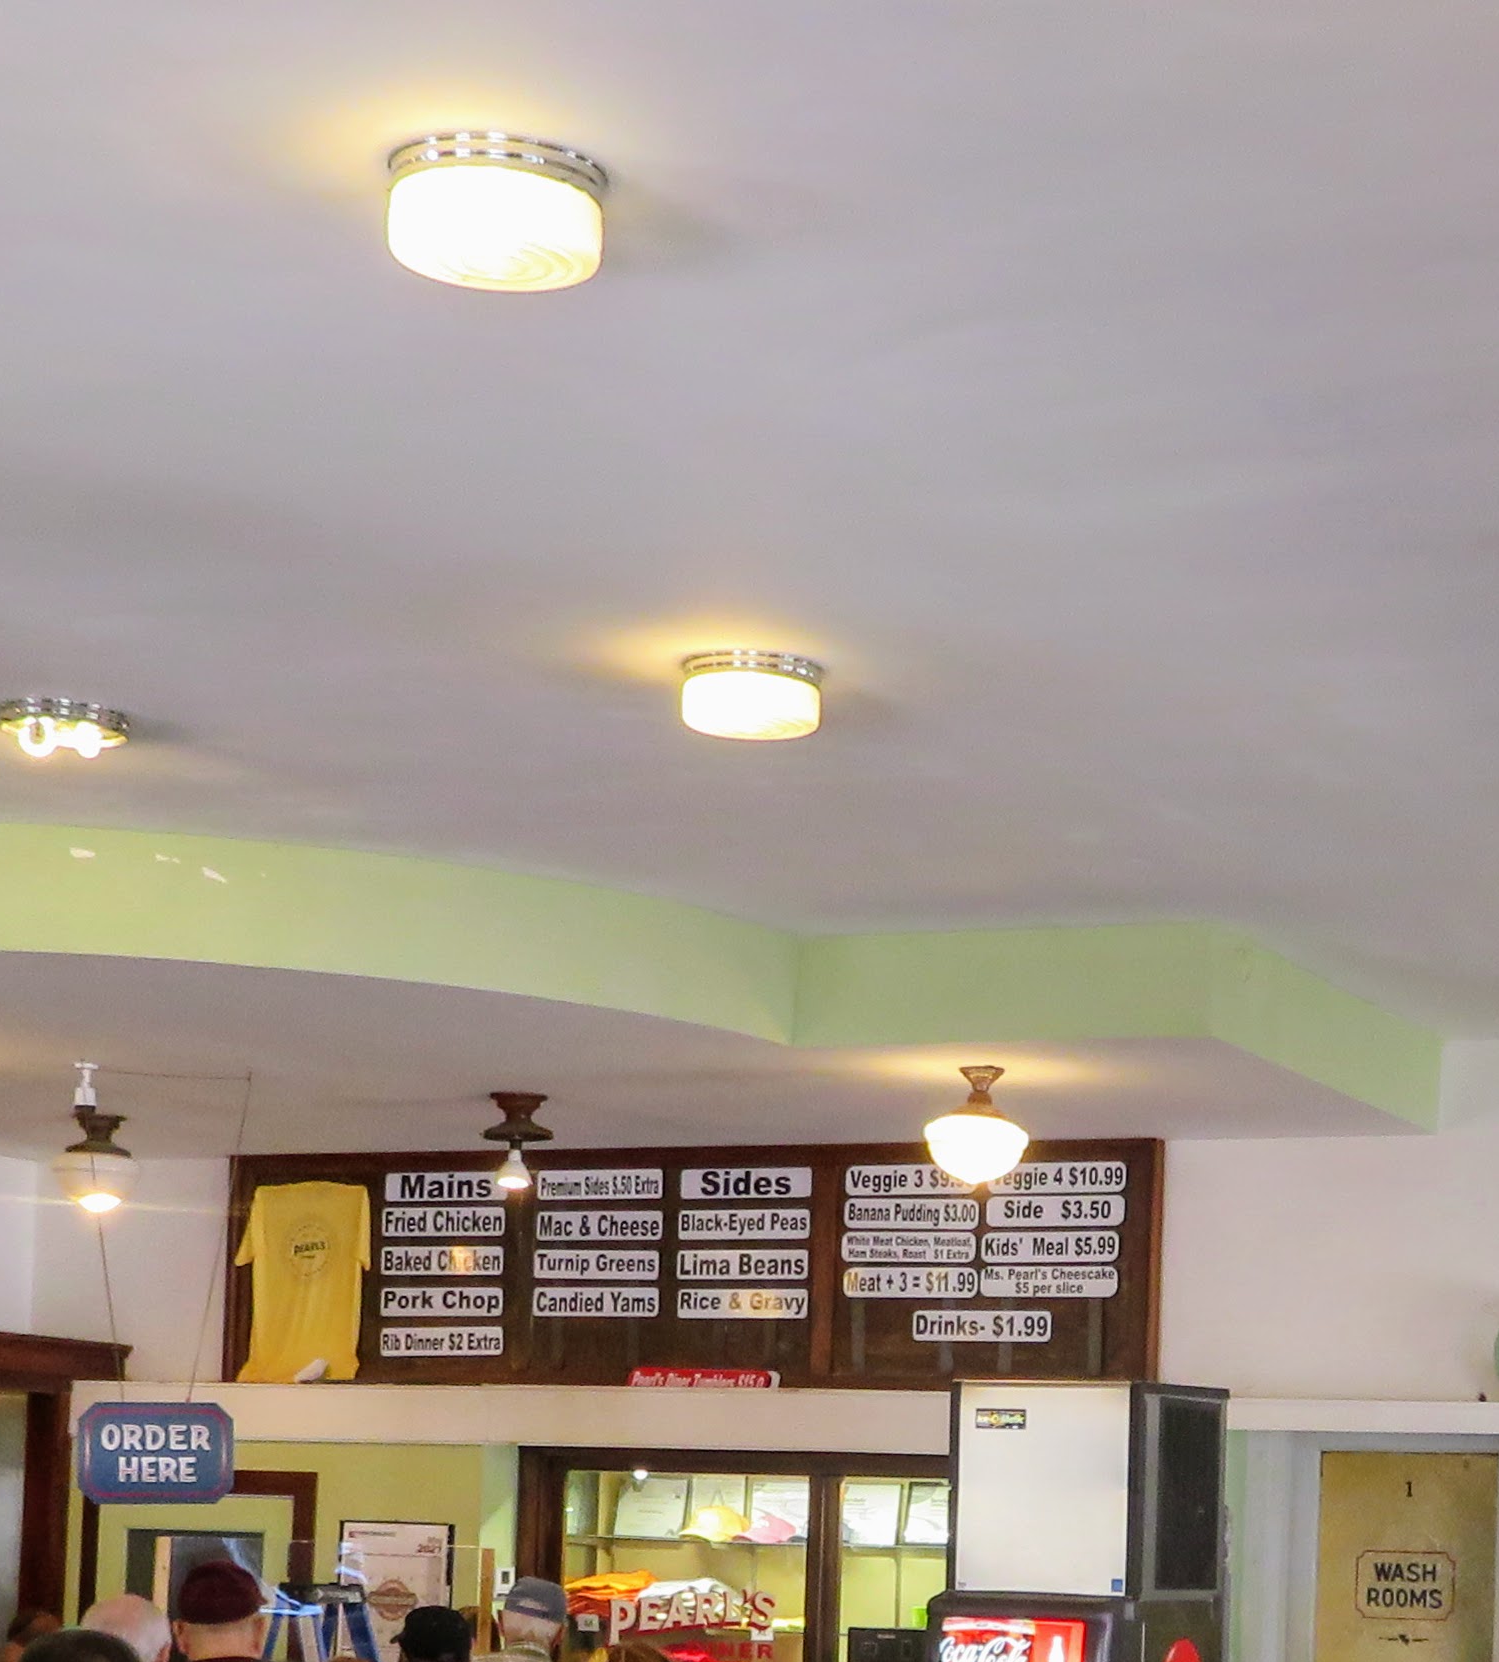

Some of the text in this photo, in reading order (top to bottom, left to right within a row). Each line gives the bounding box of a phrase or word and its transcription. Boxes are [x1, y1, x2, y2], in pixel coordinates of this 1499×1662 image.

[401, 1174, 491, 1198] Mains
[541, 1175, 659, 1196] Premium Sides $.50 Extra
[701, 1170, 792, 1196] Sides
[850, 1169, 967, 1193] Veggie 3 $9.
[994, 1166, 1124, 1190] eggie 4 $10.99
[384, 1211, 502, 1232] Fried Chicken
[848, 1203, 977, 1227] Banana Pudding $3.00
[1004, 1200, 1112, 1220] Side $3.50
[539, 1214, 660, 1236] Mac & Cheese
[681, 1213, 807, 1236] Black-Eyed Peas
[872, 1236, 893, 1246] Meat
[985, 1236, 1116, 1257] Kids' Meal $5.99
[383, 1250, 501, 1271] Baked Chcken
[537, 1253, 656, 1276] Turnip Greens
[679, 1253, 805, 1276] Lima Beans
[848, 1249, 867, 1258] Ham
[902, 1249, 926, 1259] Roast
[947, 1249, 970, 1260] Extra
[847, 1272, 882, 1292] Meat
[899, 1272, 907, 1292] 3
[926, 1271, 975, 1294] $11.99
[984, 1269, 1004, 1280] Ms.
[1008, 1269, 1048, 1281] Pearl's
[1015, 1282, 1084, 1296] $5 per slice
[383, 1290, 500, 1313] Pork Chop
[536, 1292, 656, 1312] Candied Yams
[680, 1292, 806, 1315] Rice & Gravy
[915, 1314, 1048, 1338] Drinks- $1.99
[382, 1332, 501, 1351] Rib Dinner $2 Extra
[101, 1424, 212, 1452] ORDER
[117, 1456, 198, 1484] HERE
[1374, 1562, 1437, 1582] WASH
[1366, 1587, 1443, 1609] ROOMS
[608, 1588, 777, 1647] PEARL'S
